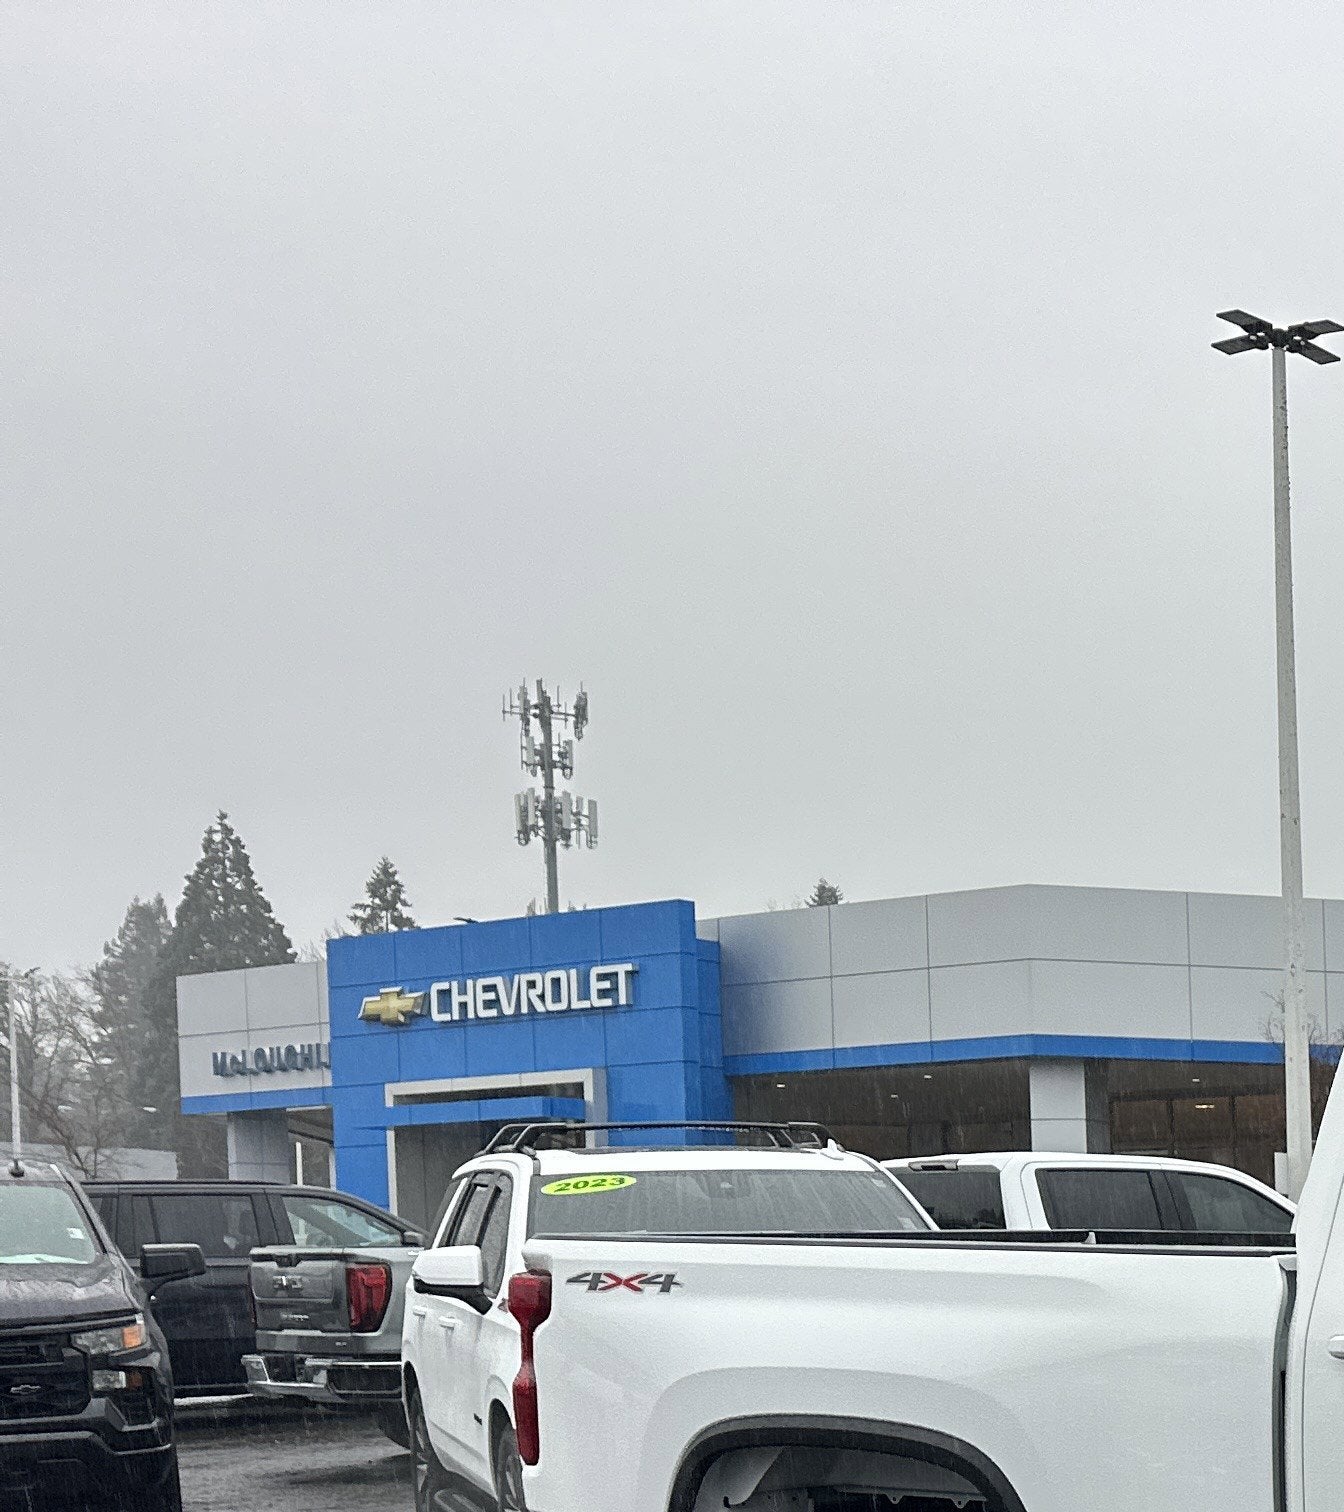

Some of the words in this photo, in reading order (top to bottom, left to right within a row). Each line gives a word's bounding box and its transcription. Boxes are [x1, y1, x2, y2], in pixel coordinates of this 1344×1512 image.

[430, 962, 635, 1023] CHEVROLET
[212, 1042, 332, 1077] McLOUGHLI
[553, 1177, 625, 1193] 2023
